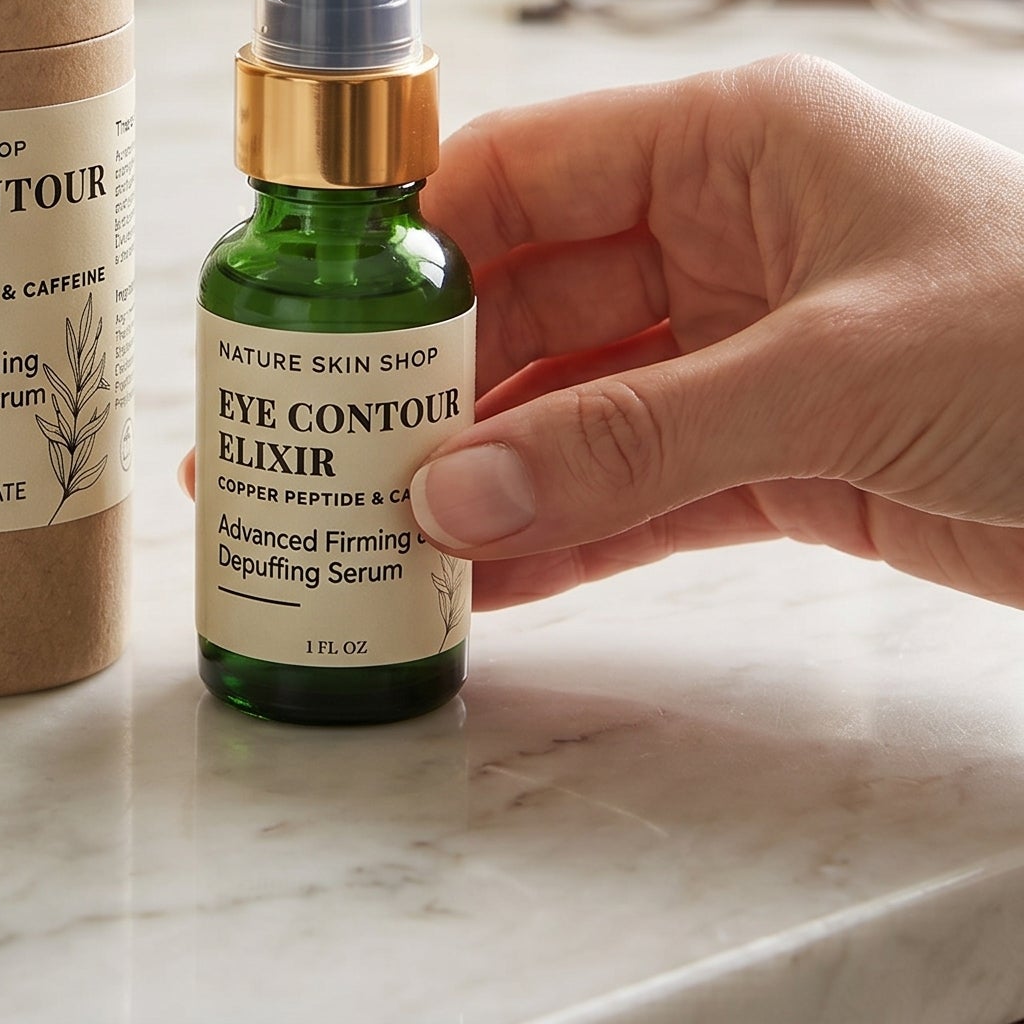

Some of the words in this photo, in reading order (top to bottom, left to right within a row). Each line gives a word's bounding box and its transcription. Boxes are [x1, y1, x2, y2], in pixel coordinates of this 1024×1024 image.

[1, 284, 16, 300] &
[23, 266, 105, 299] CAFFEINE
[220, 340, 301, 372] NATURE
[312, 356, 370, 374] SKIN
[380, 347, 438, 372] SHOP
[218, 386, 276, 429] EYE
[288, 388, 460, 434] CONTOUR
[218, 430, 336, 477] ELIXIR
[218, 476, 278, 503] COPPER
[285, 490, 366, 507] PEPTIDE
[371, 492, 384, 505] &
[218, 514, 317, 553] Advanced
[326, 529, 411, 554] Firming
[219, 542, 320, 589] Depuffing
[328, 561, 402, 584] Serum
[306, 641, 313, 653] 1
[317, 641, 338, 654] FL
[343, 641, 368, 654] OZ
